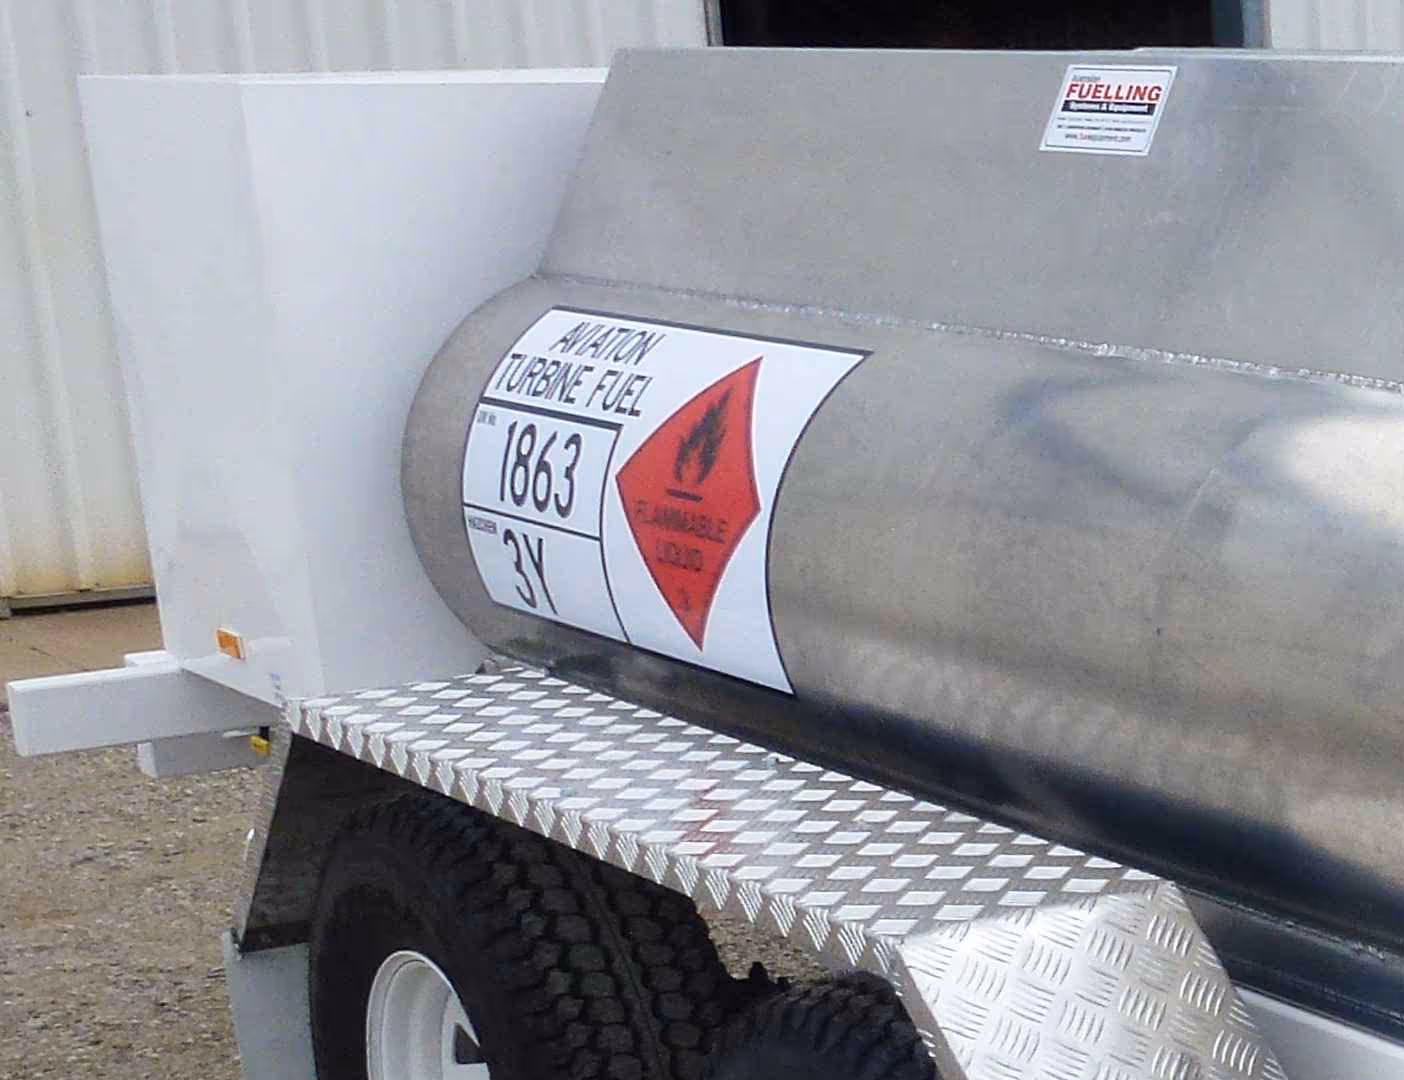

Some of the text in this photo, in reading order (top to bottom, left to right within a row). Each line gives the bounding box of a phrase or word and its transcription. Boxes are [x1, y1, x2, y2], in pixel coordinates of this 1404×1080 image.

[1066, 83, 1163, 101] FUELLING
[548, 321, 667, 366] AVIATION
[494, 352, 654, 417] TURBINE FUEL
[500, 420, 583, 520] 1863
[502, 527, 559, 616] 3Y
